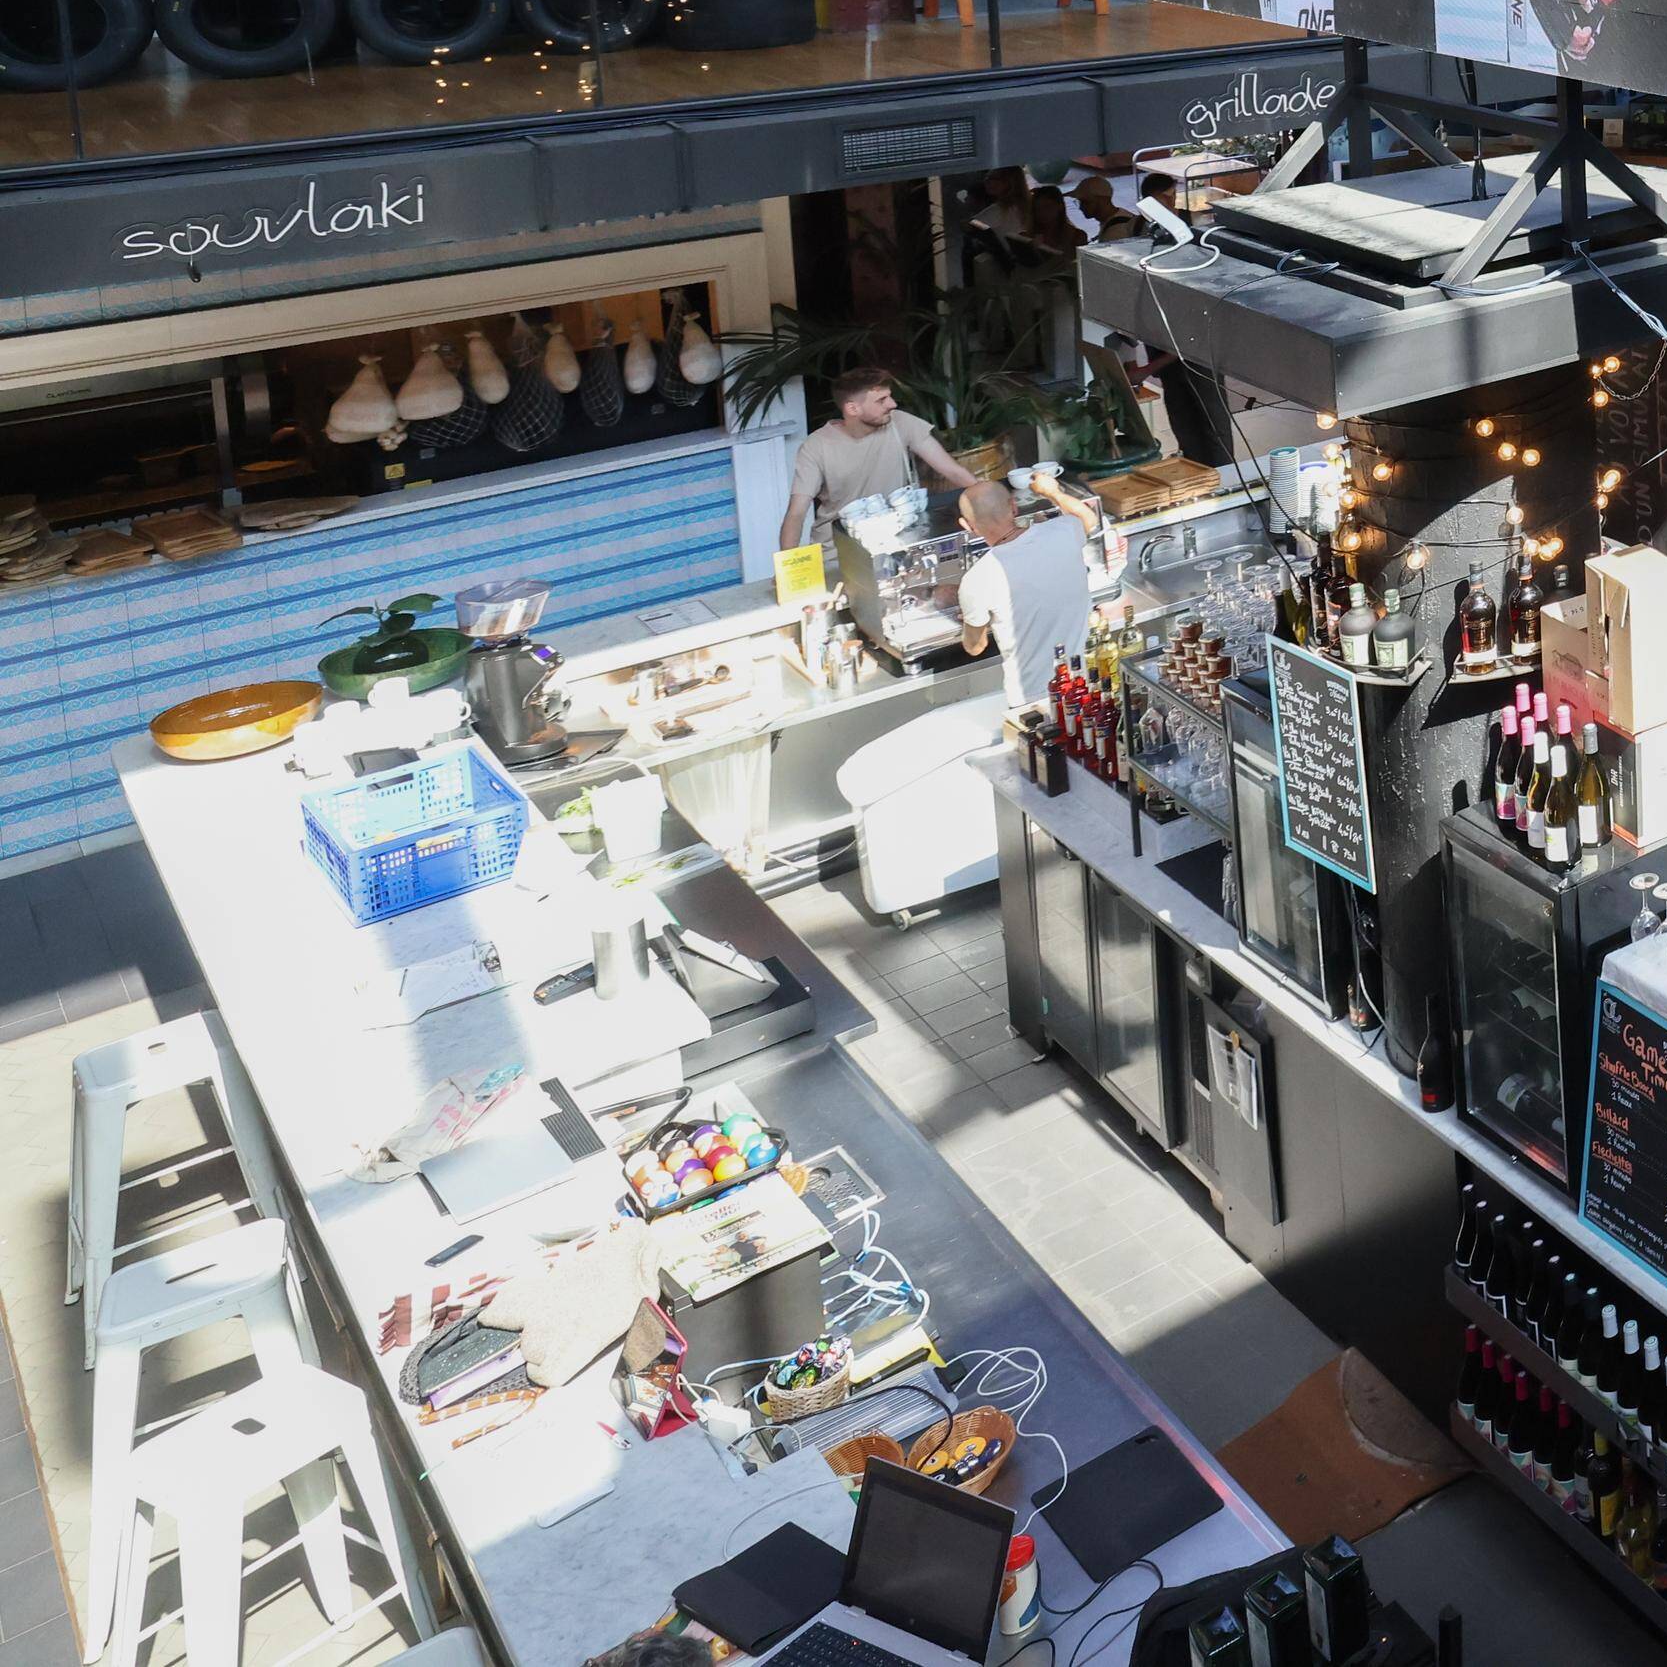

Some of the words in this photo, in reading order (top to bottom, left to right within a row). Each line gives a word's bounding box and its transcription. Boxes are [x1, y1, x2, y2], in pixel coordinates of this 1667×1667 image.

[1298, 1, 1335, 33] ONE
[1186, 72, 1337, 139] grillade
[122, 181, 424, 261] souvlaki
[1623, 1023, 1667, 1075] Game
[1594, 1101, 1630, 1131] Billard
